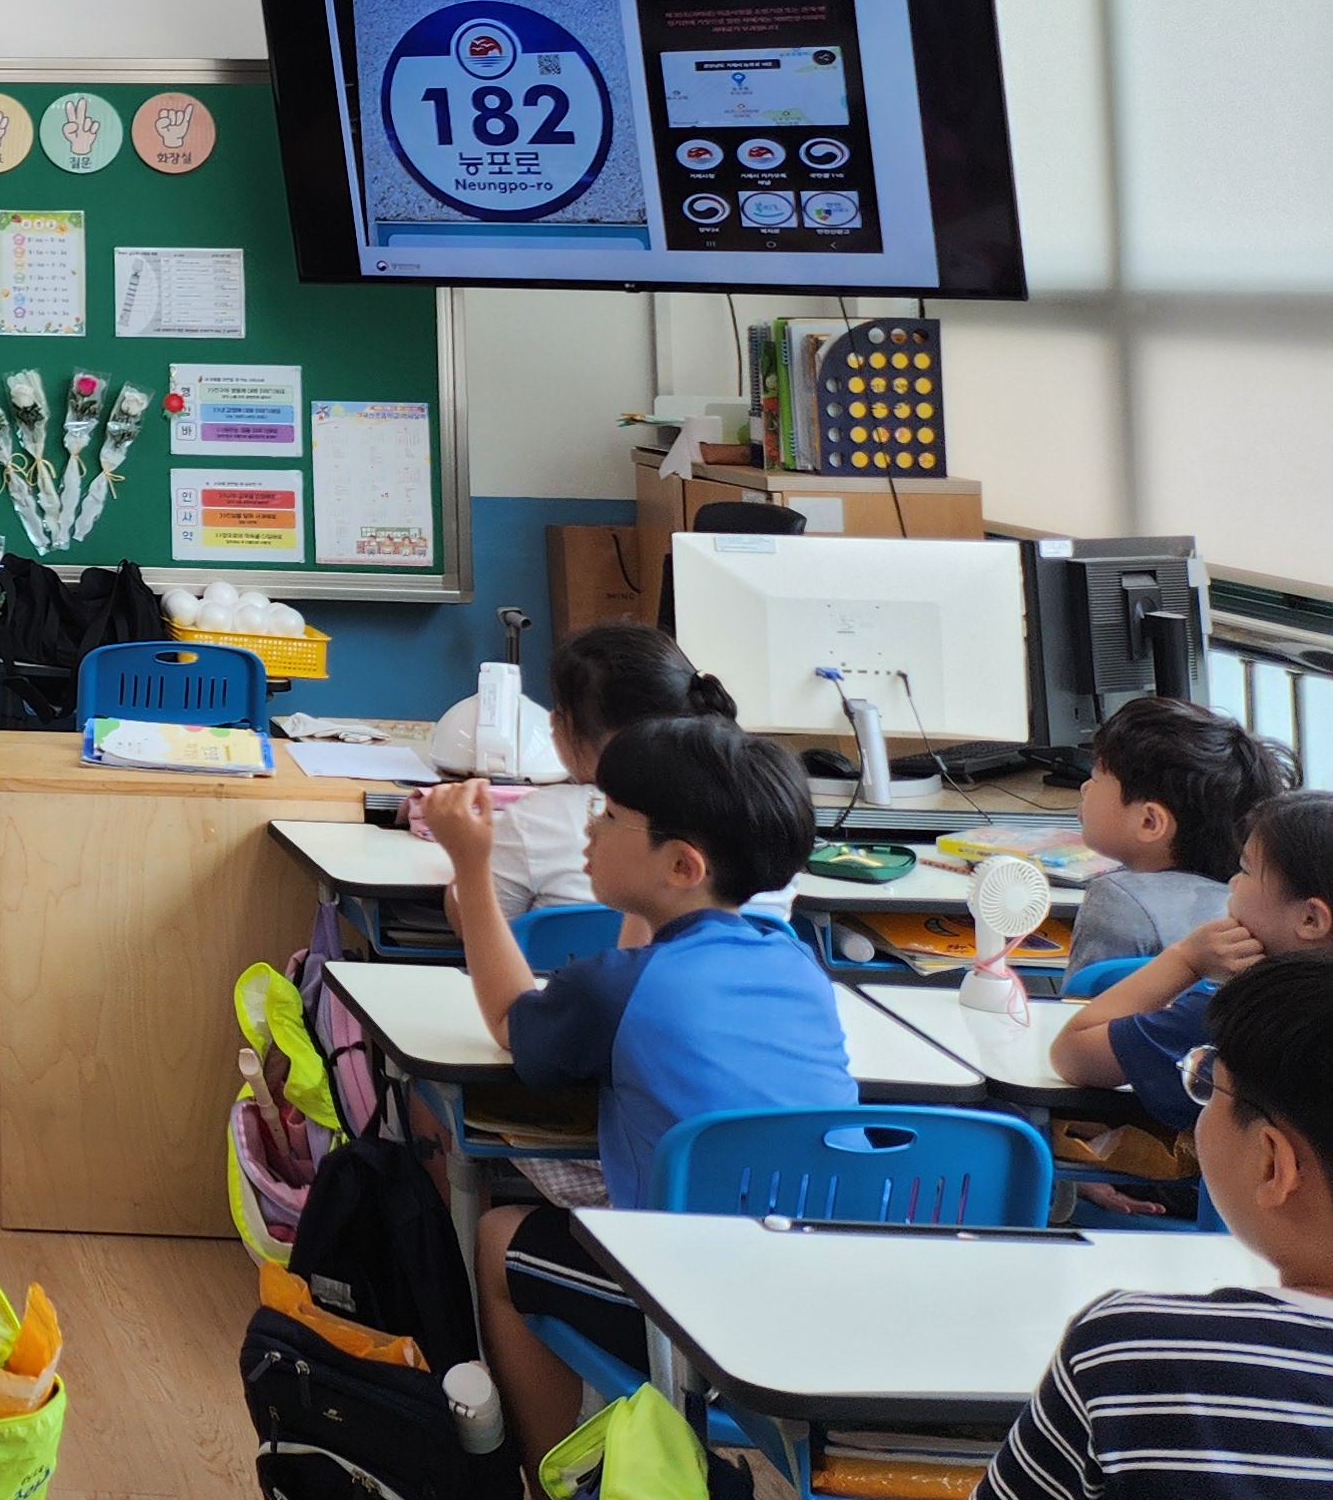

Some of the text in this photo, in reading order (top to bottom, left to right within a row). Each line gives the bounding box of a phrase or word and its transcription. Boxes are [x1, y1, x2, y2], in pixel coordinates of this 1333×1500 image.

[420, 84, 576, 147] 182
[69, 156, 93, 170] 질문
[156, 152, 193, 165] 화장실
[458, 151, 543, 177] 능포로
[454, 177, 554, 194] Neungpo-ro
[182, 490, 192, 503] 인
